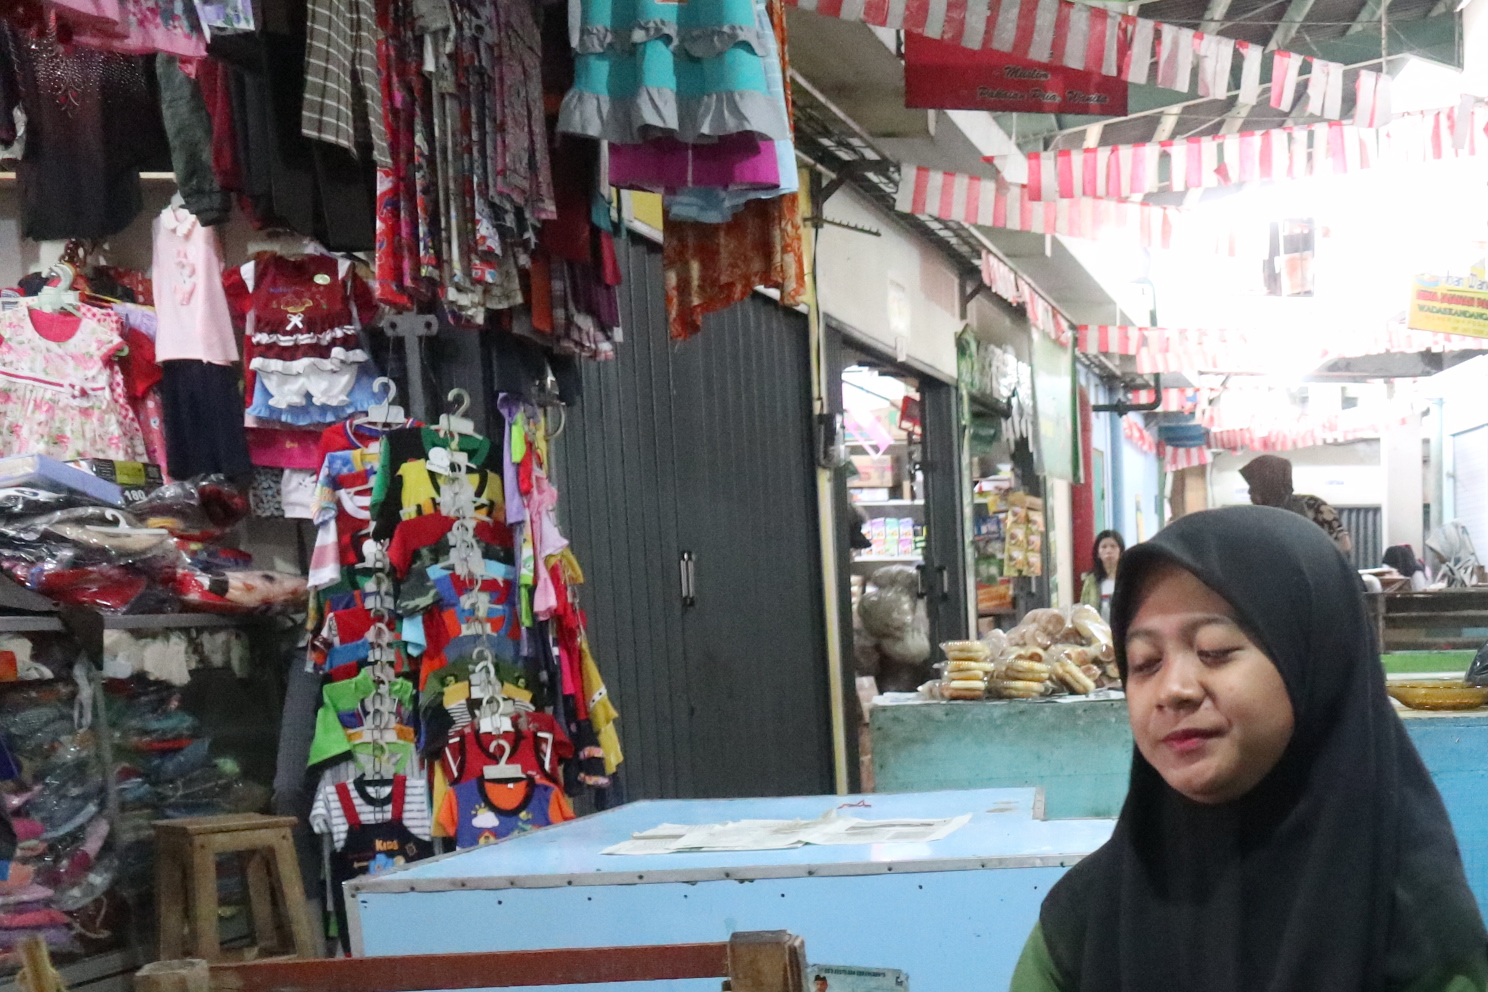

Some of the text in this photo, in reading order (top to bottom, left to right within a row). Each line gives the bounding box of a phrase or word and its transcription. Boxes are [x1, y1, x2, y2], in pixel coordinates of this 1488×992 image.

[1004, 65, 1050, 80] Muslim
[977, 86, 1026, 101] Pakaian
[124, 489, 145, 501] 180
